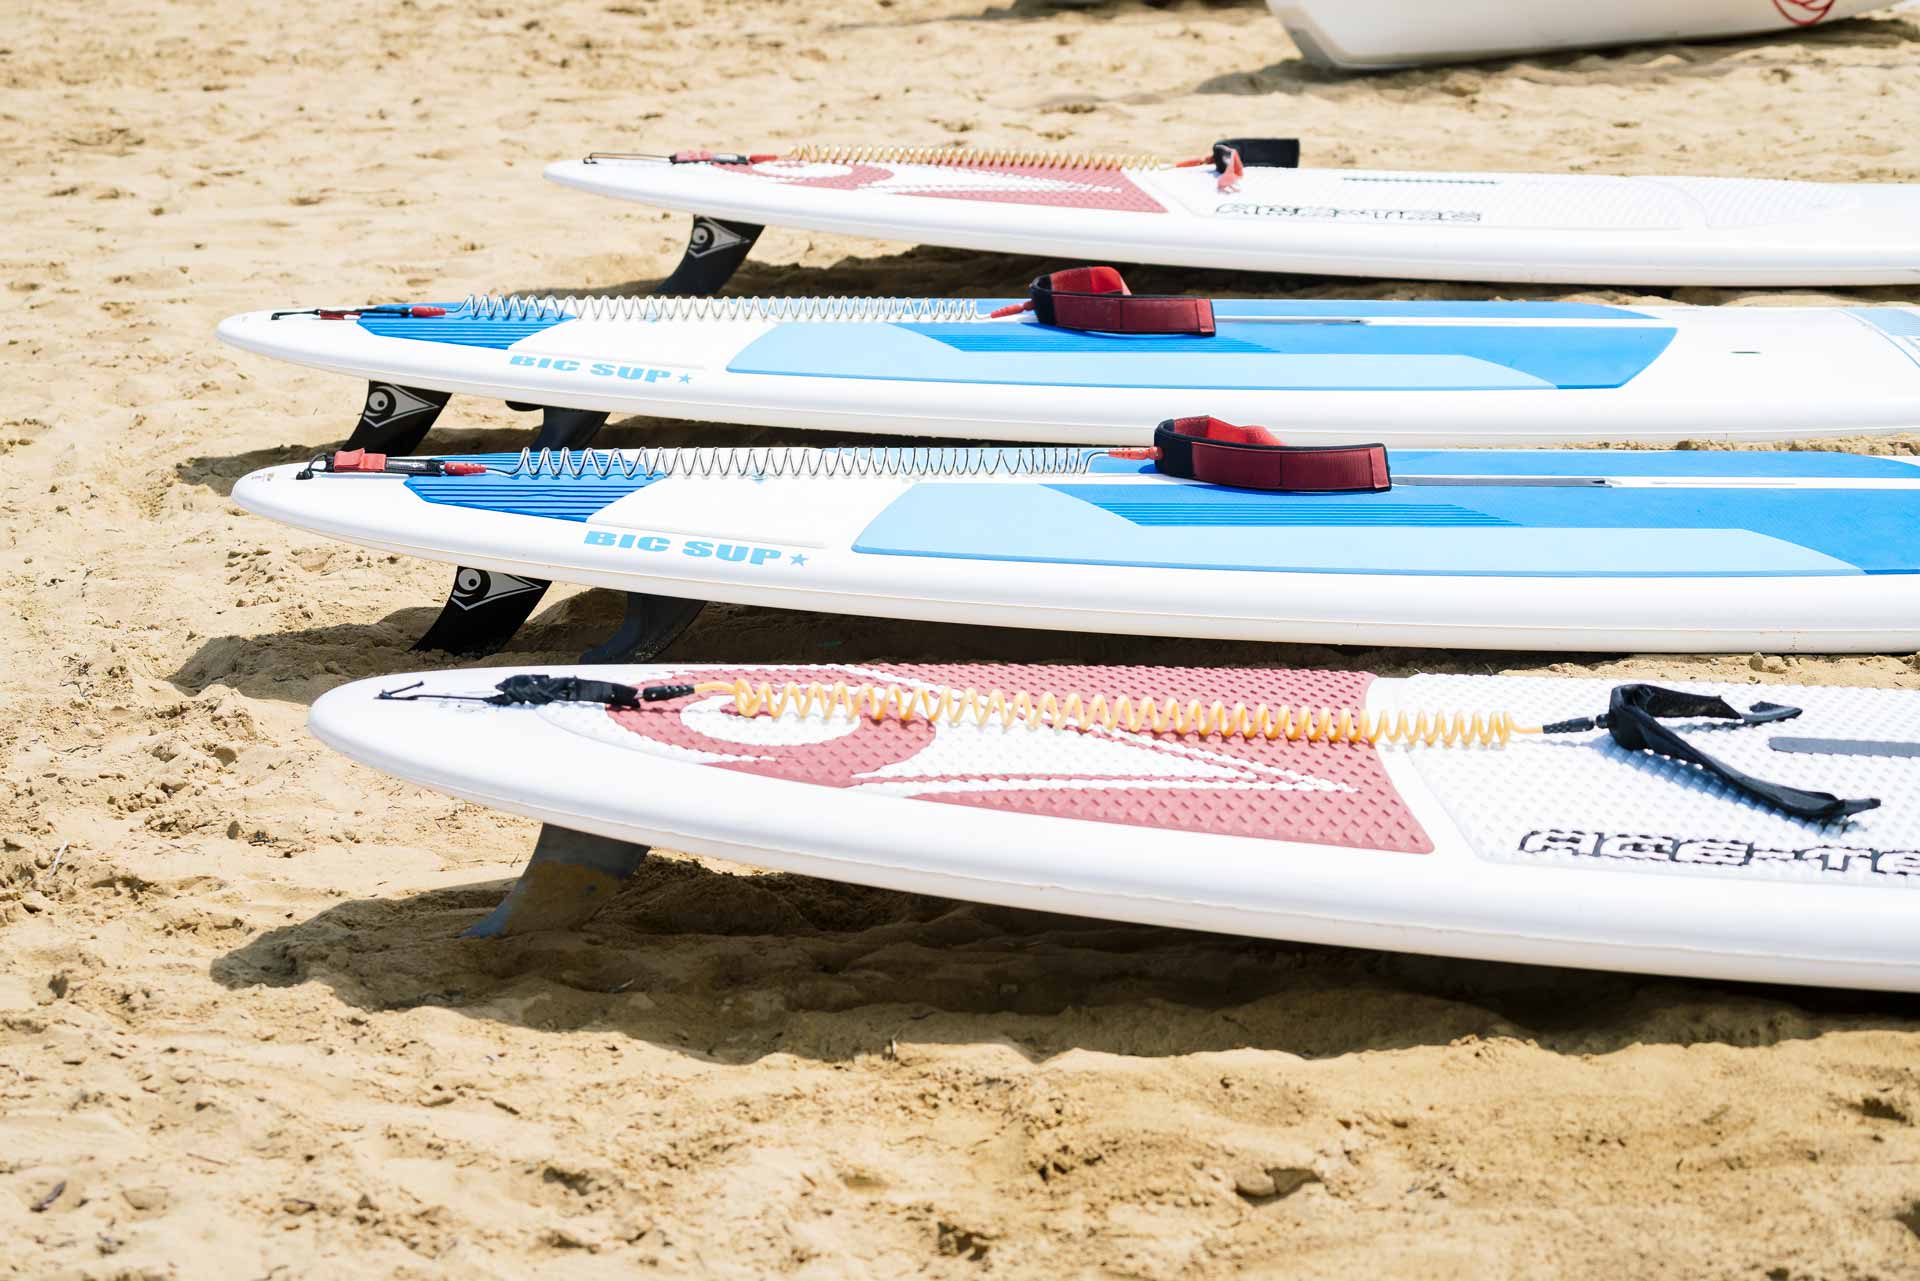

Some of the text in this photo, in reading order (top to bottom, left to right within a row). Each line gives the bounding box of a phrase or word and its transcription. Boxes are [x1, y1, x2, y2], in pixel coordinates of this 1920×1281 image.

[509, 354, 672, 384] BIC SUP
[583, 530, 782, 566] BIC SUP
